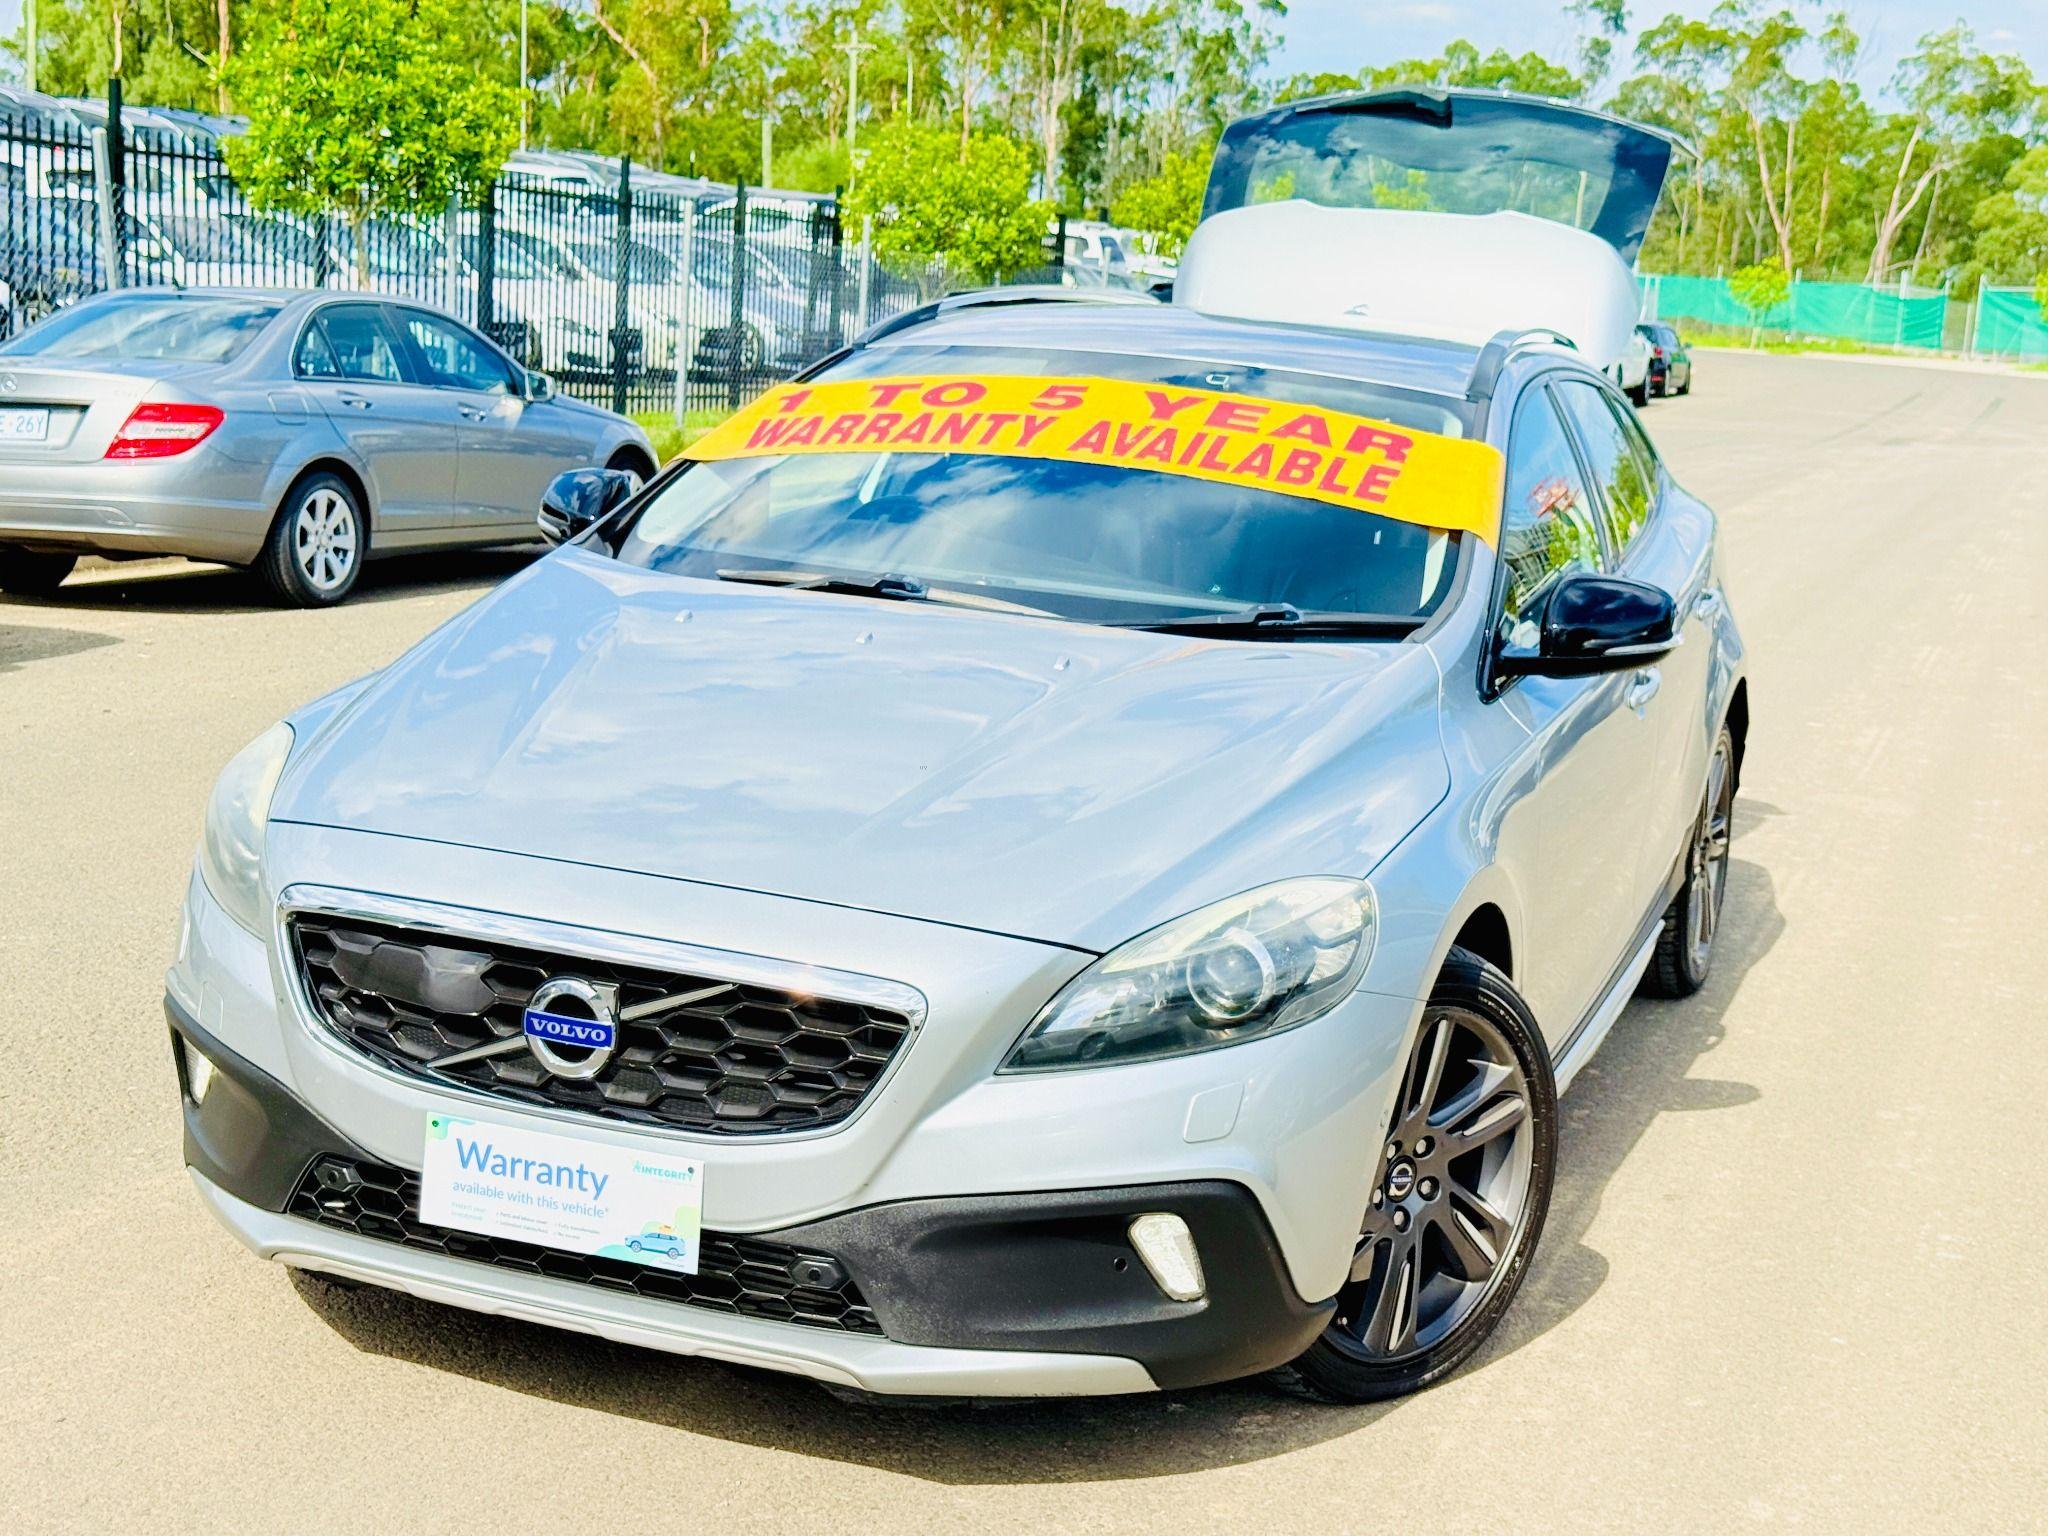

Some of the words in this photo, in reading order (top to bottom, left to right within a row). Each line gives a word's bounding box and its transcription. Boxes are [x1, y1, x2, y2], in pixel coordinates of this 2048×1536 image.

[775, 390, 813, 412] 1
[868, 382, 987, 408] TO
[1029, 385, 1089, 411] 5
[1144, 391, 1414, 463] YEAR
[744, 413, 1058, 449] WARRANTY
[1067, 420, 1400, 503] AVAILABLE
[530, 1017, 607, 1042] VOLVO
[452, 1180, 504, 1199] available
[507, 1191, 534, 1205] with
[537, 1196, 558, 1210] this
[456, 1138, 609, 1200] Warranty
